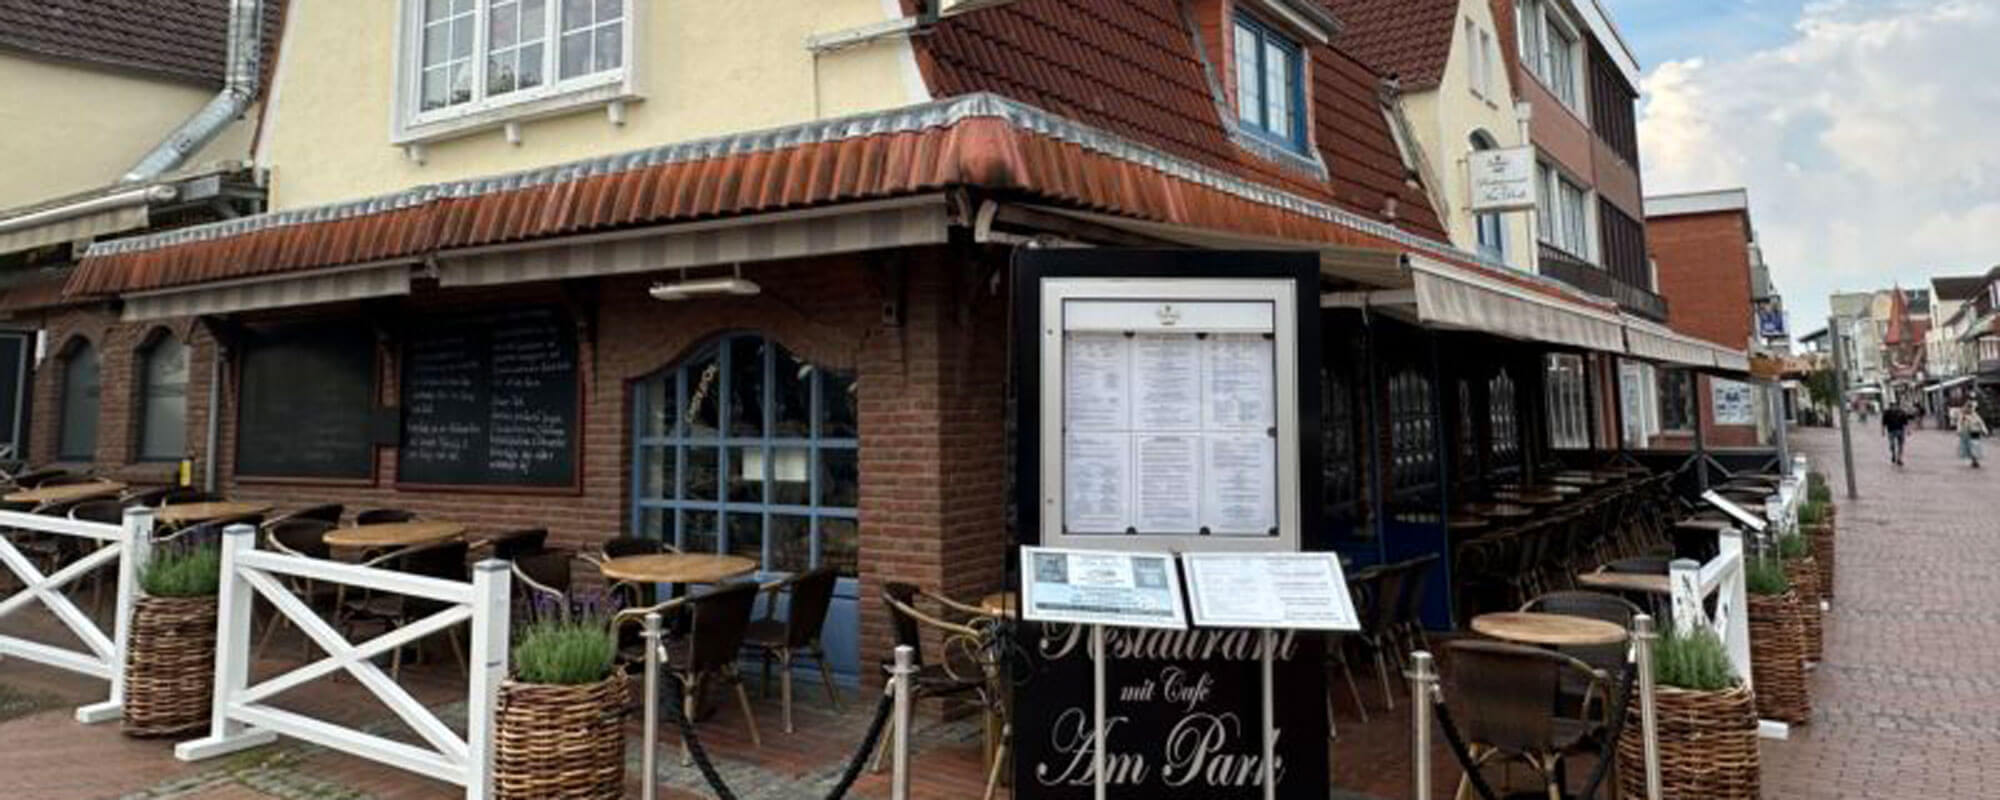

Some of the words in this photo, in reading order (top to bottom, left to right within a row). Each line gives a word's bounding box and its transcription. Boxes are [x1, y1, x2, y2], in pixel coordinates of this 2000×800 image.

[1120, 678, 1155, 701] mit
[1160, 664, 1214, 713] Café
[1036, 706, 1149, 786] Am
[1161, 711, 1286, 787] Park
